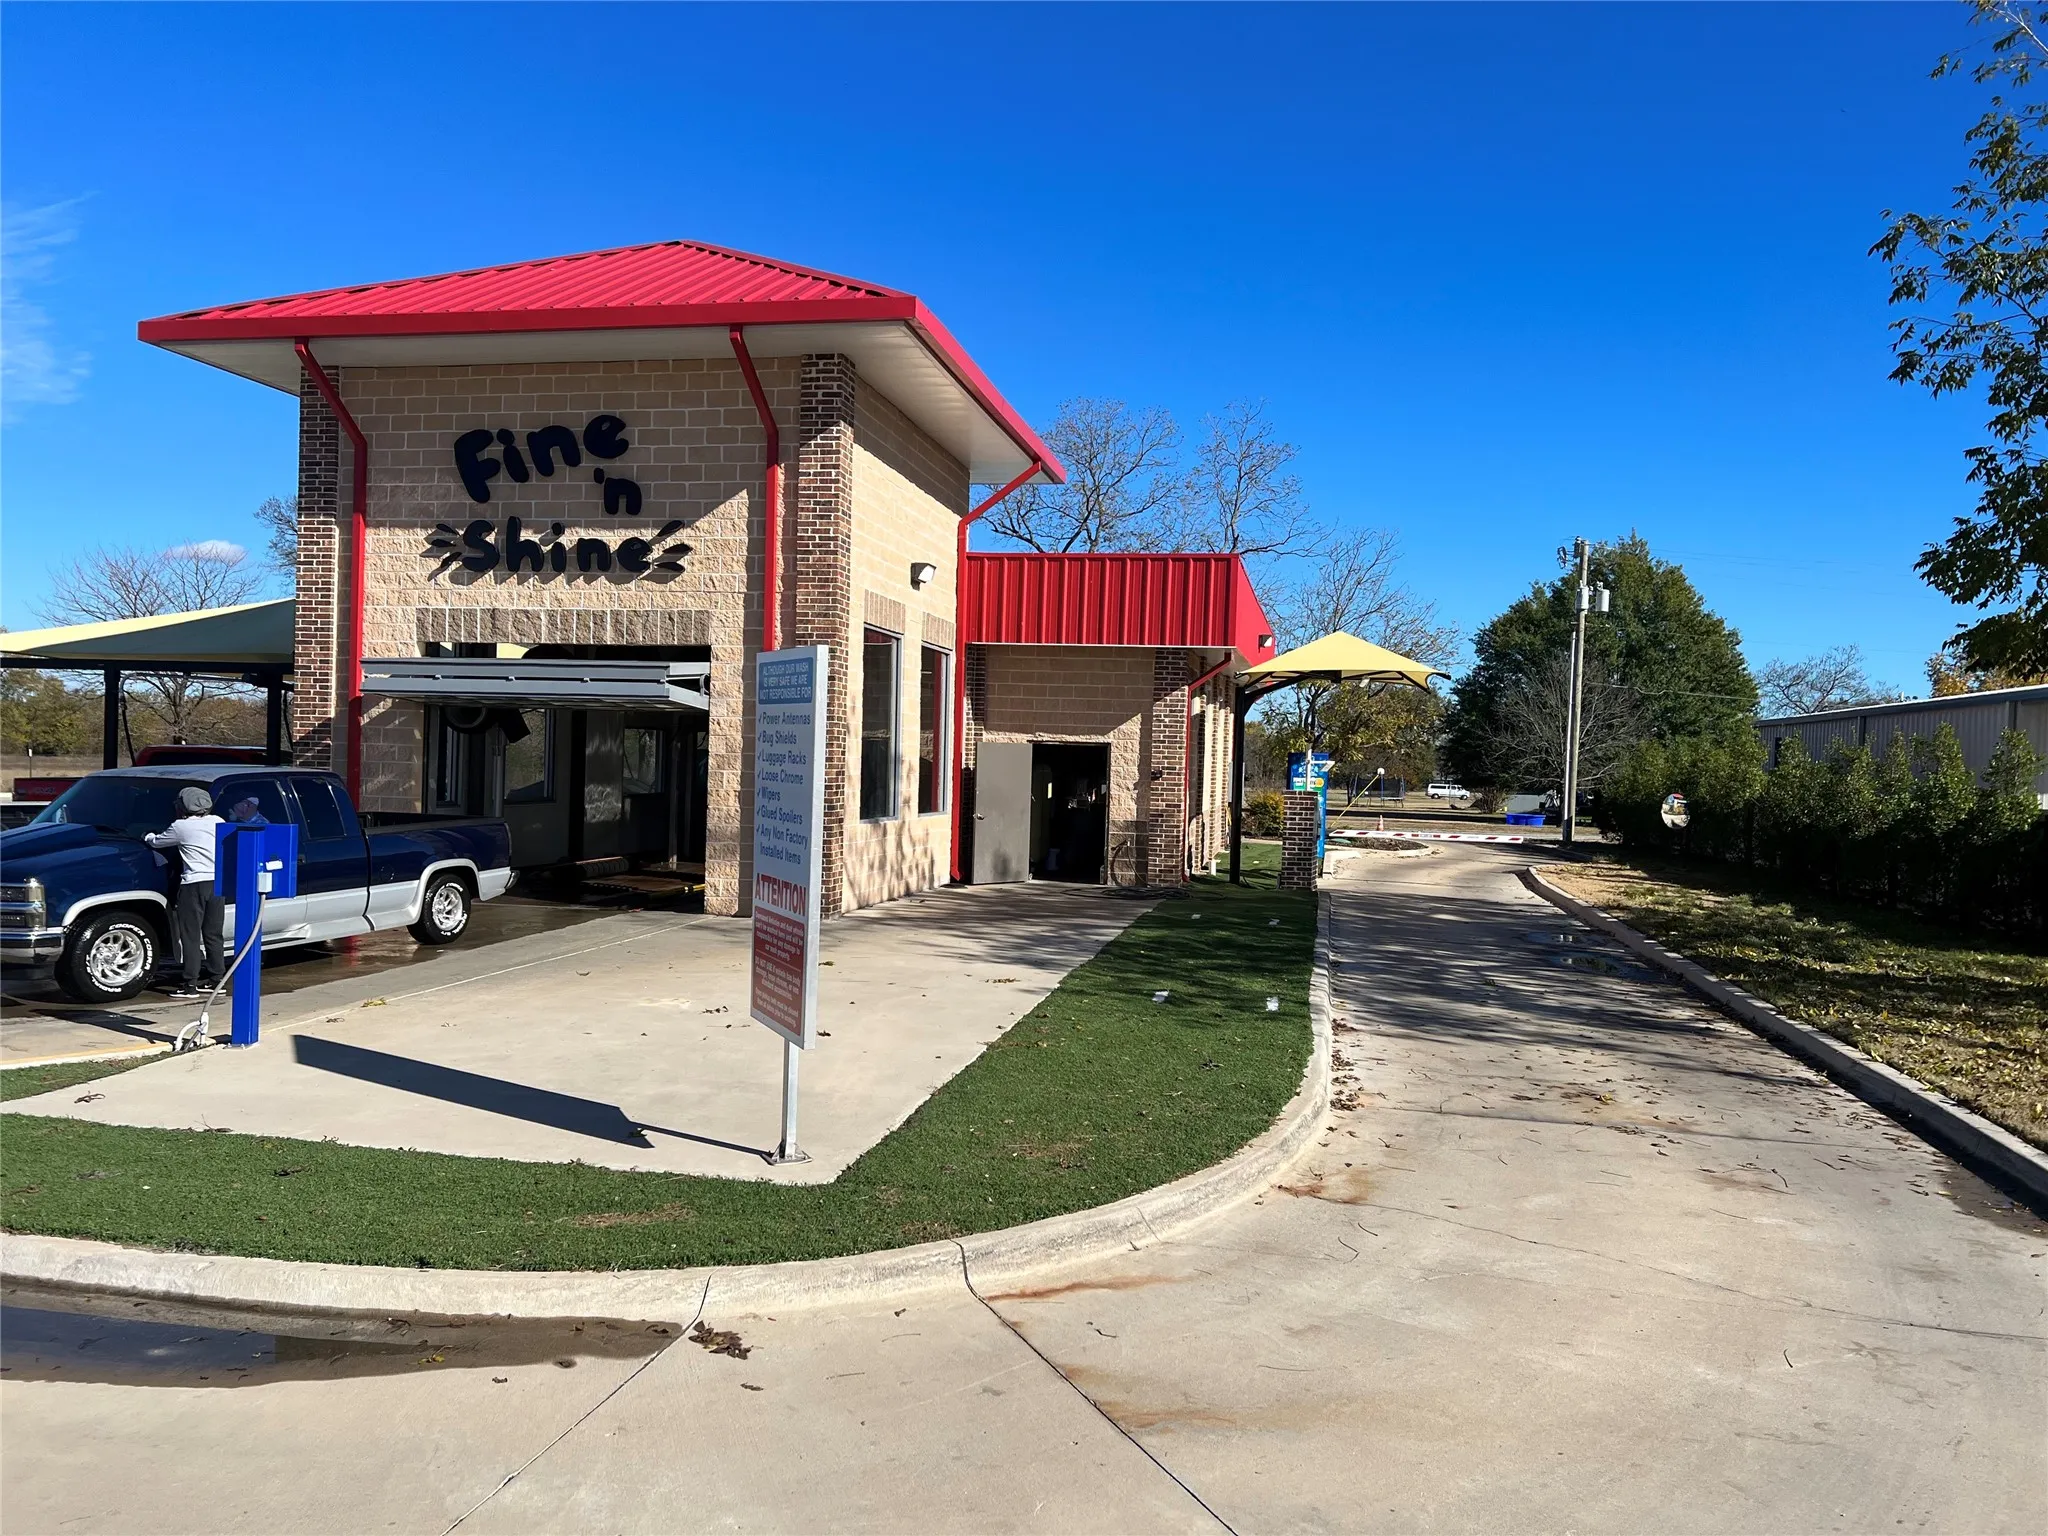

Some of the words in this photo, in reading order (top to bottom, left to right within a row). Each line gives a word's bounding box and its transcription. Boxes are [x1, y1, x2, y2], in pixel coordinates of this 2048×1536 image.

[454, 414, 629, 504] Fine
[461, 516, 651, 573] Shine
[763, 665, 785, 676] ALTHOUGH
[786, 663, 795, 674] OUR
[796, 662, 809, 673] WASH
[763, 677, 768, 687] IS
[768, 676, 779, 687] VERY
[779, 675, 790, 686] SAFE
[791, 675, 798, 685] WE
[798, 674, 808, 685] ARE
[760, 689, 769, 700] NOT
[769, 687, 801, 699] RESPONSIBLE
[801, 686, 812, 698] FOR
[762, 711, 780, 725] Power
[781, 711, 811, 725] Antennas
[762, 730, 774, 747] Bug
[775, 730, 797, 744] Shields
[762, 749, 786, 767] Luggage
[787, 750, 807, 765] Racks
[762, 768, 779, 782] Loose
[780, 768, 804, 785] Chrome
[761, 786, 780, 803] Wipers
[761, 804, 778, 820] Glued
[778, 807, 803, 825] Spoilers
[761, 823, 772, 842] Any
[773, 825, 784, 841] Non
[785, 828, 808, 850] Factory
[760, 841, 783, 860] Installed
[784, 847, 801, 865] Items
[754, 872, 806, 917] ATTENTION
[108, 923, 146, 937] COOPER
[143, 937, 153, 970] COBRA
